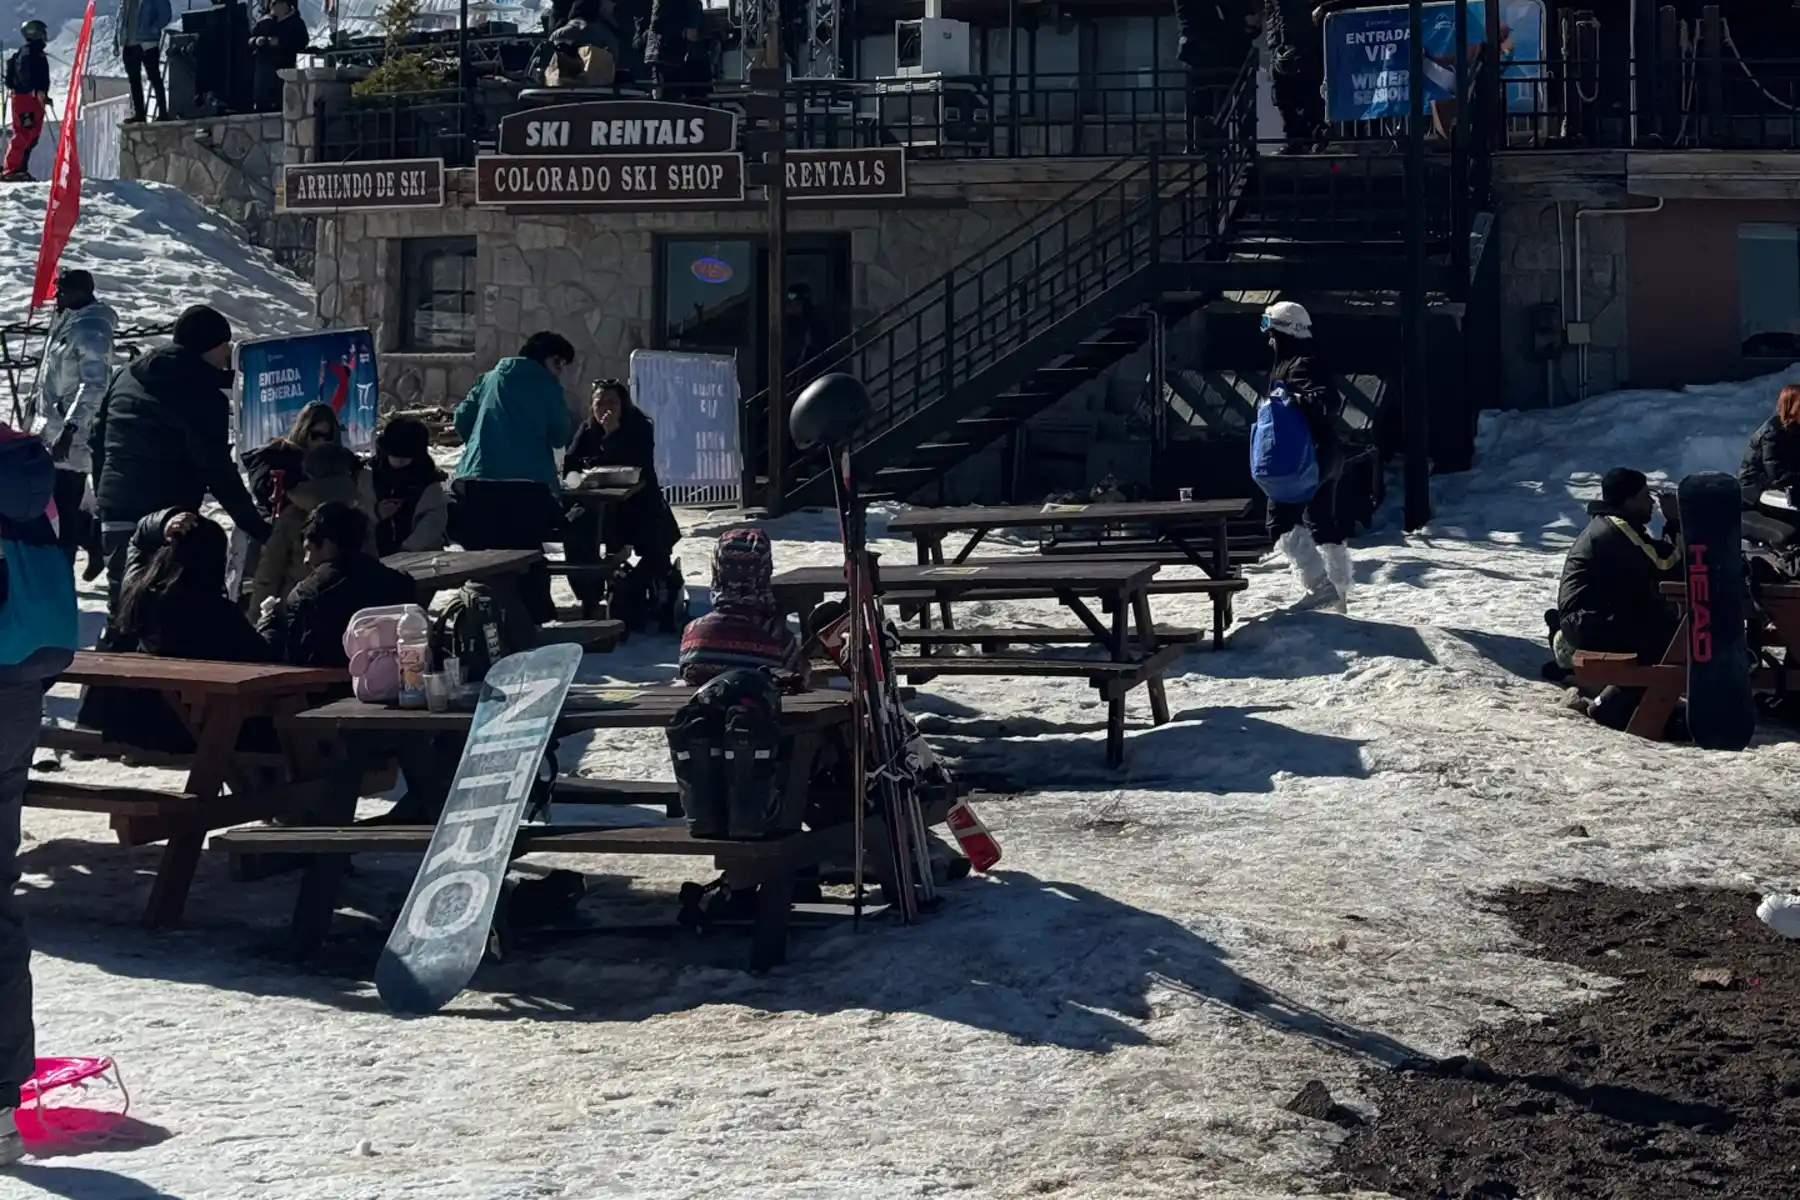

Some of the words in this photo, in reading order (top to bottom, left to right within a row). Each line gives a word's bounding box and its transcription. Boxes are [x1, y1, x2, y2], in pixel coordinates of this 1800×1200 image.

[1345, 28, 1410, 44] ENTRADA
[1364, 43, 1397, 62] VIP
[525, 120, 570, 146] SKI
[591, 118, 705, 146] RENTALS
[297, 173, 372, 199] ARRIENDO
[376, 171, 395, 198] DE
[400, 170, 426, 197] SKI
[494, 165, 611, 192] COLORADO
[621, 165, 657, 191] SKI
[668, 164, 724, 191] SHOP
[785, 159, 886, 188] RENTALS
[258, 368, 301, 387] ENTRADA
[1688, 544, 1712, 663] HEAD
[407, 678, 561, 940] NITRO
